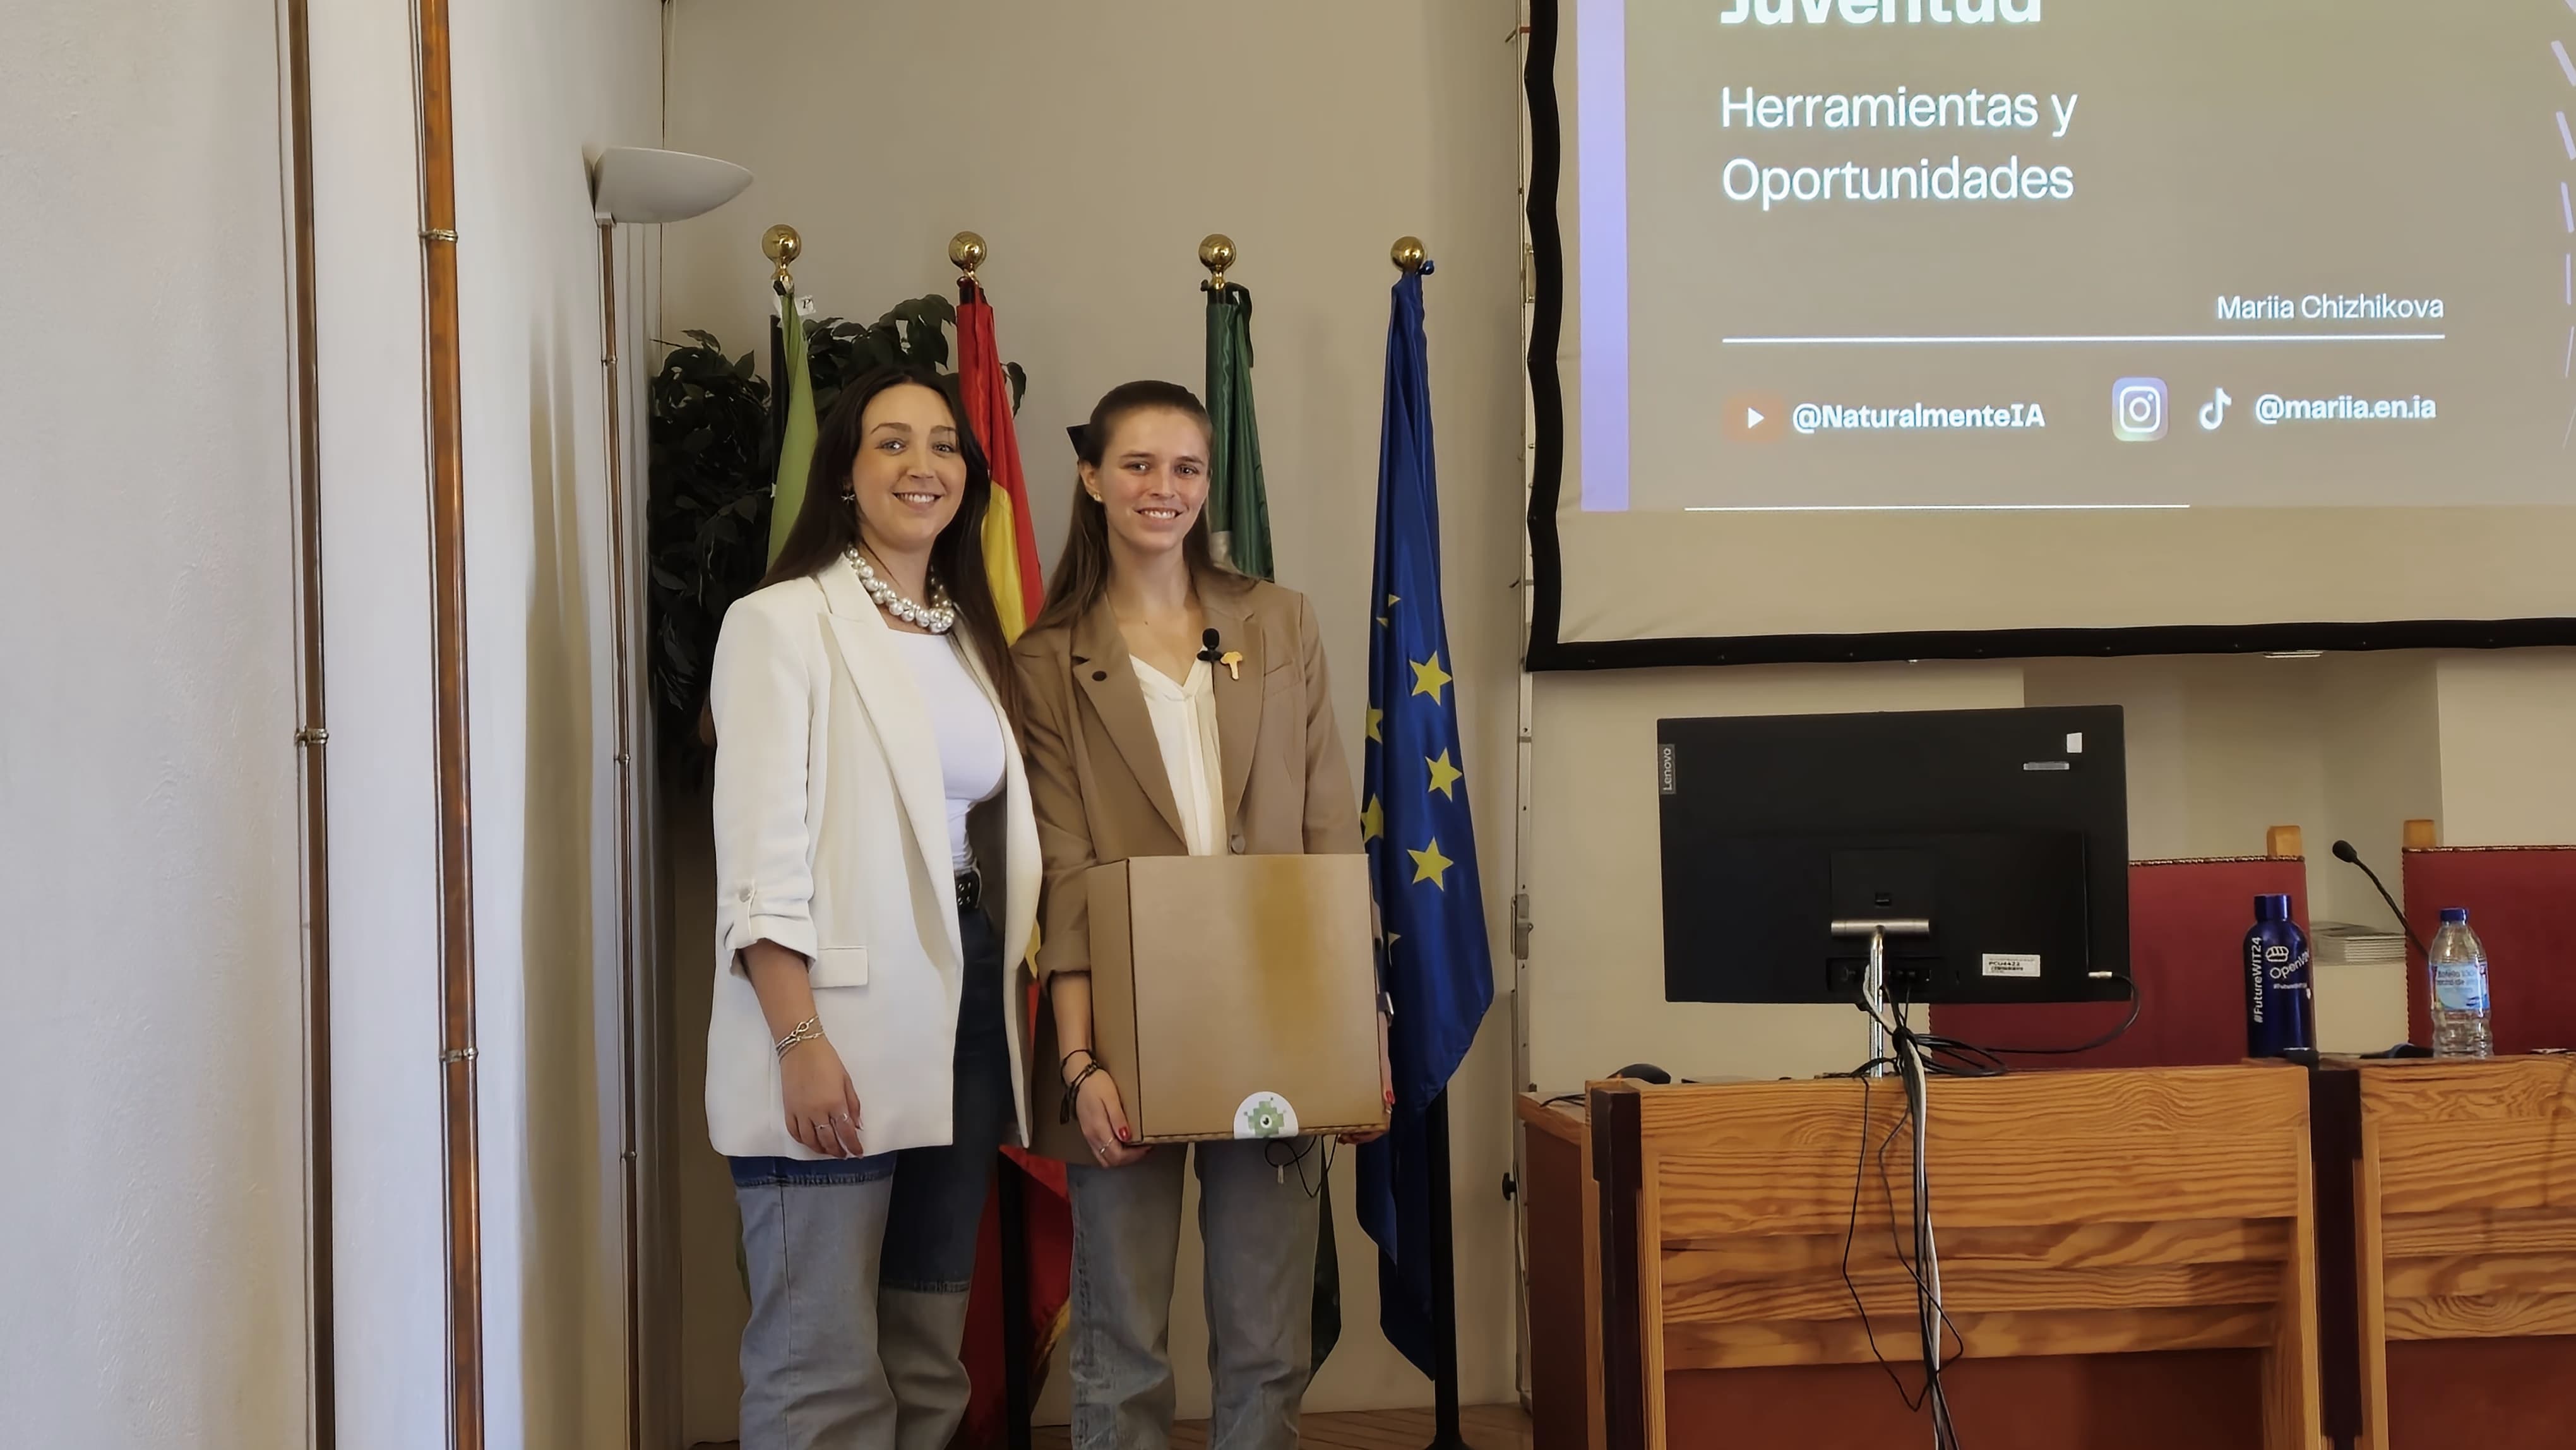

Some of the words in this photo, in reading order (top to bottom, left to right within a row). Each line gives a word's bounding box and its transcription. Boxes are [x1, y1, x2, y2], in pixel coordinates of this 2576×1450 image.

[1722, 86, 2038, 128] Herramientas
[2051, 93, 2078, 137] y
[1722, 155, 2073, 211] Oportunidades
[2217, 295, 2294, 319] Mariia
[2301, 293, 2443, 319] Chizhikova
[1792, 402, 2046, 434] @NaturalmenteIA
[2255, 393, 2436, 424] @mariia.en.ia
[1662, 747, 1673, 791] Lenovo
[2251, 937, 2263, 1023] #FutureWIT24
